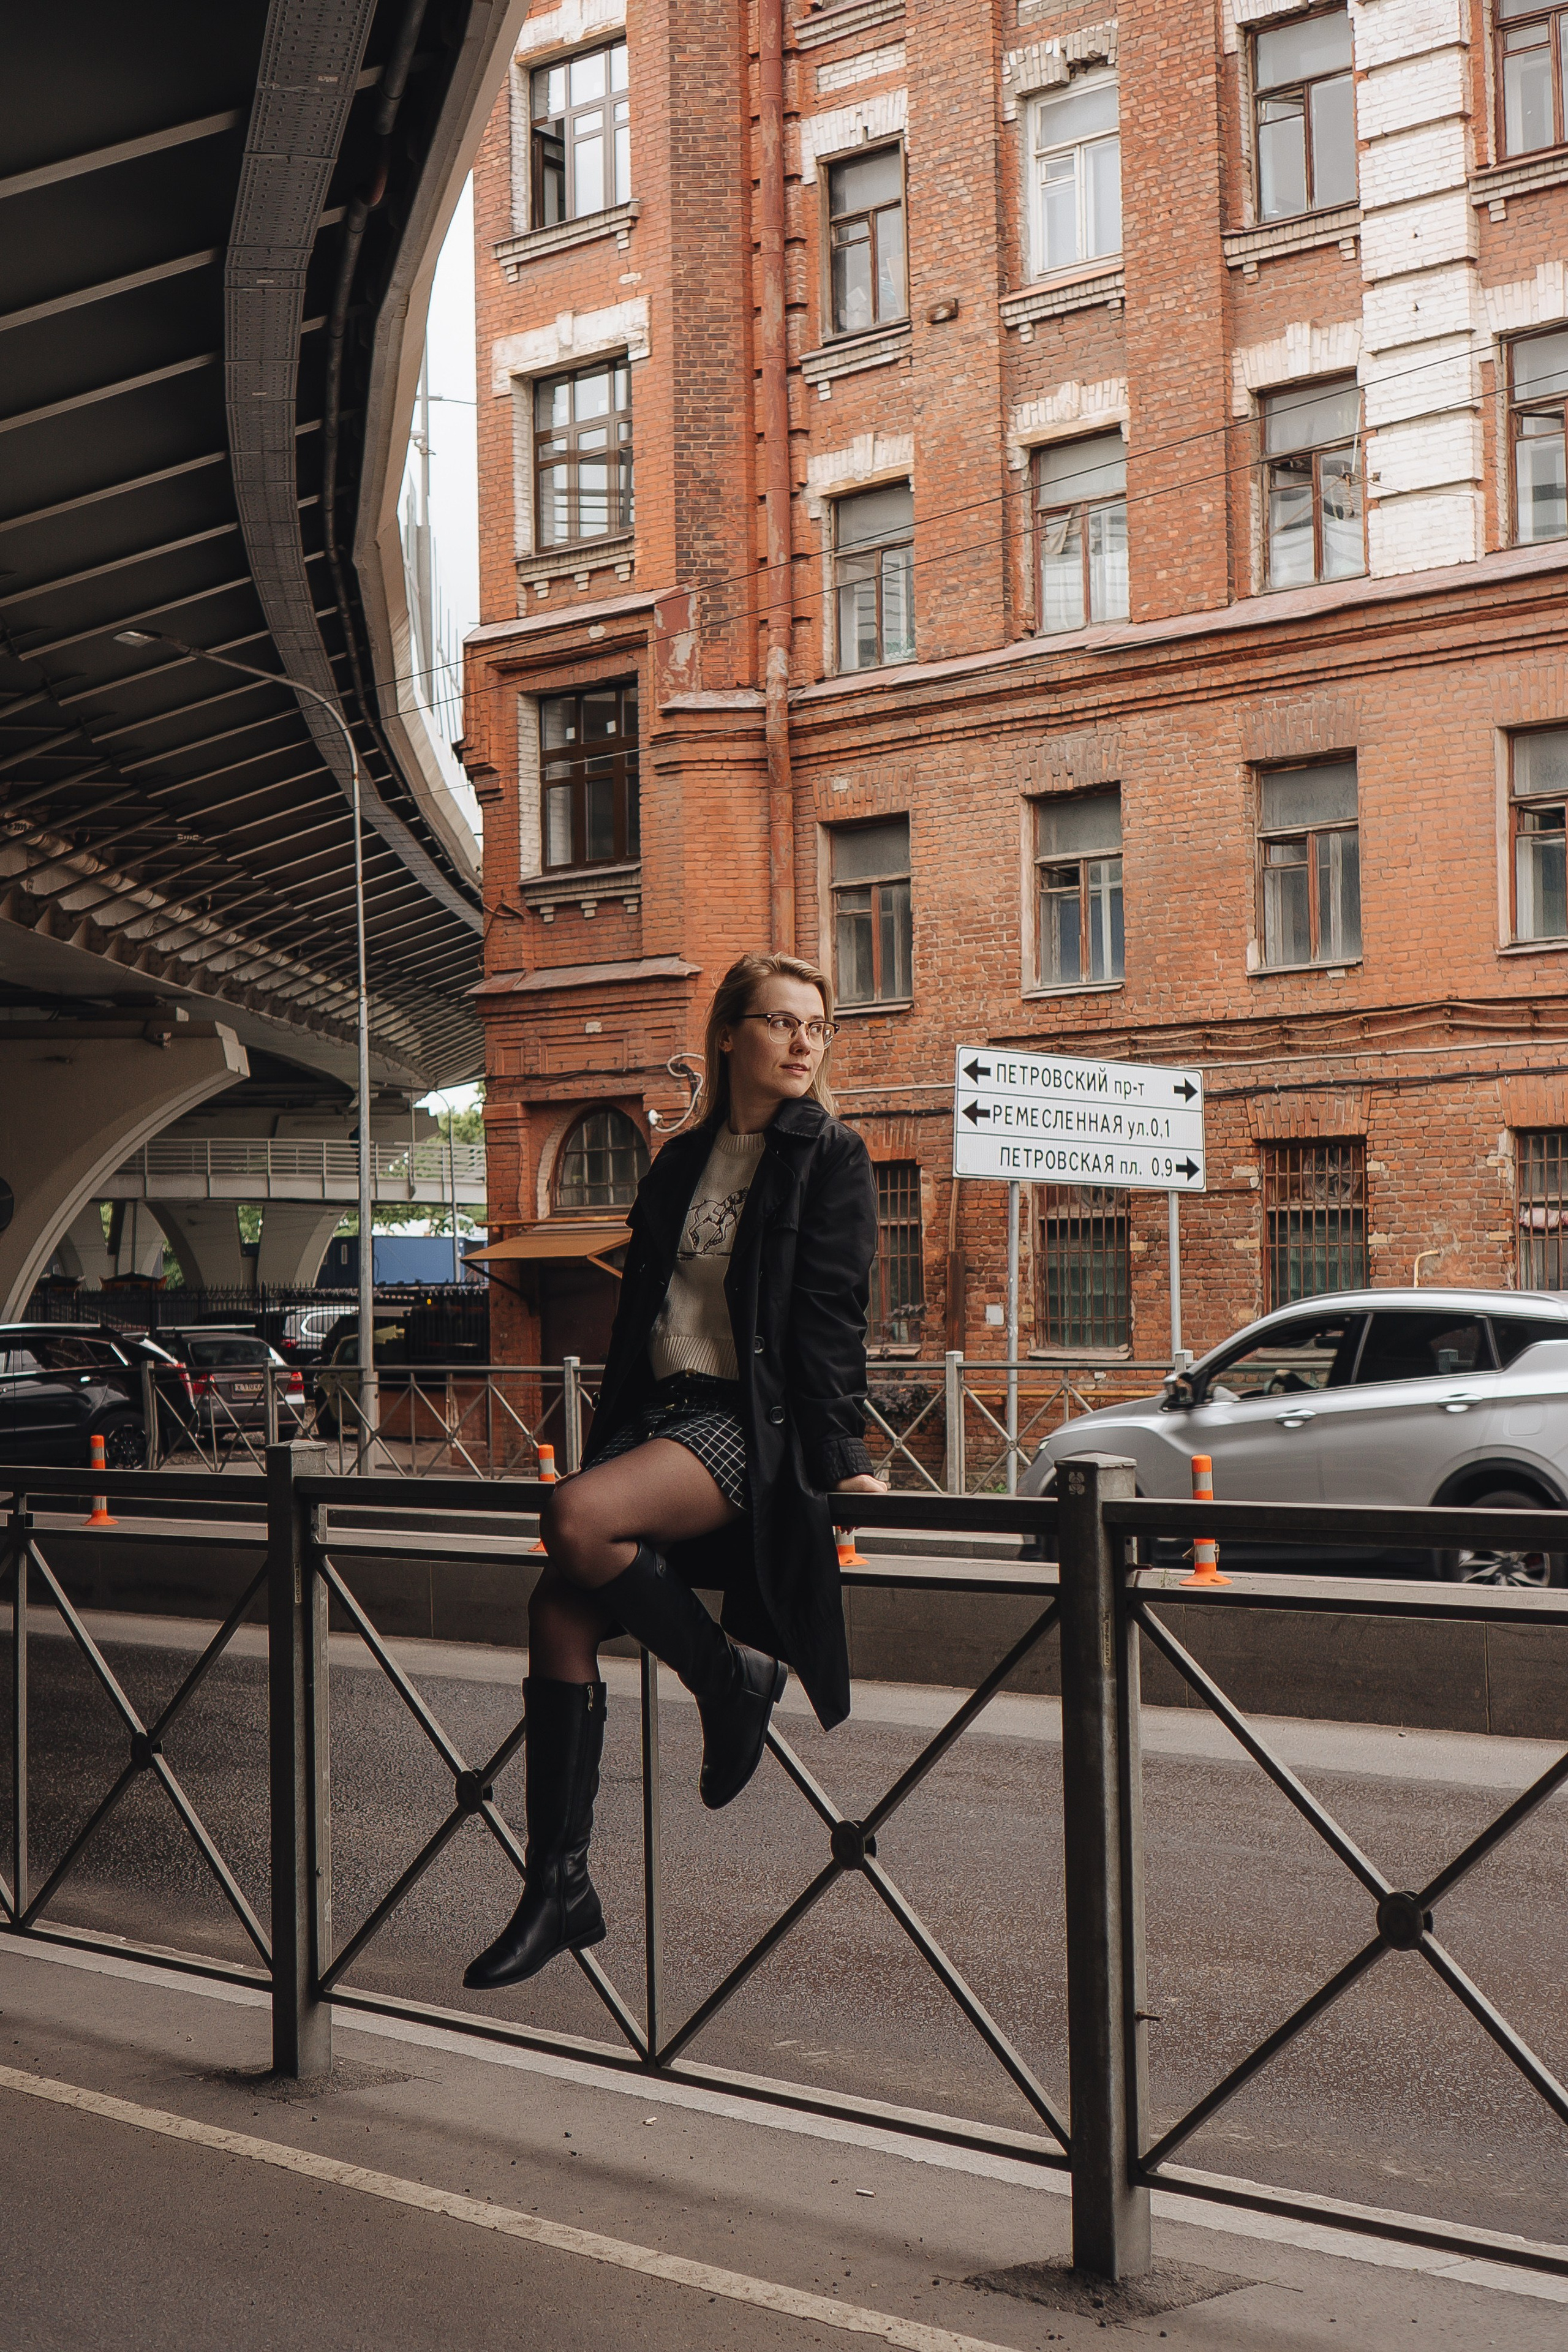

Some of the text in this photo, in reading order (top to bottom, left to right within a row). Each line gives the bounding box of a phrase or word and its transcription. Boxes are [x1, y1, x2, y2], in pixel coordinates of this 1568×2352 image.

[997, 1063, 1145, 1100] ПЕТРОВСКИЙ пр-т
[993, 1104, 1123, 1134] РЕМЕСЛЕННАЯ
[1000, 1146, 1172, 1179] ПЕТРОВСКАЯ пл. 0,9
